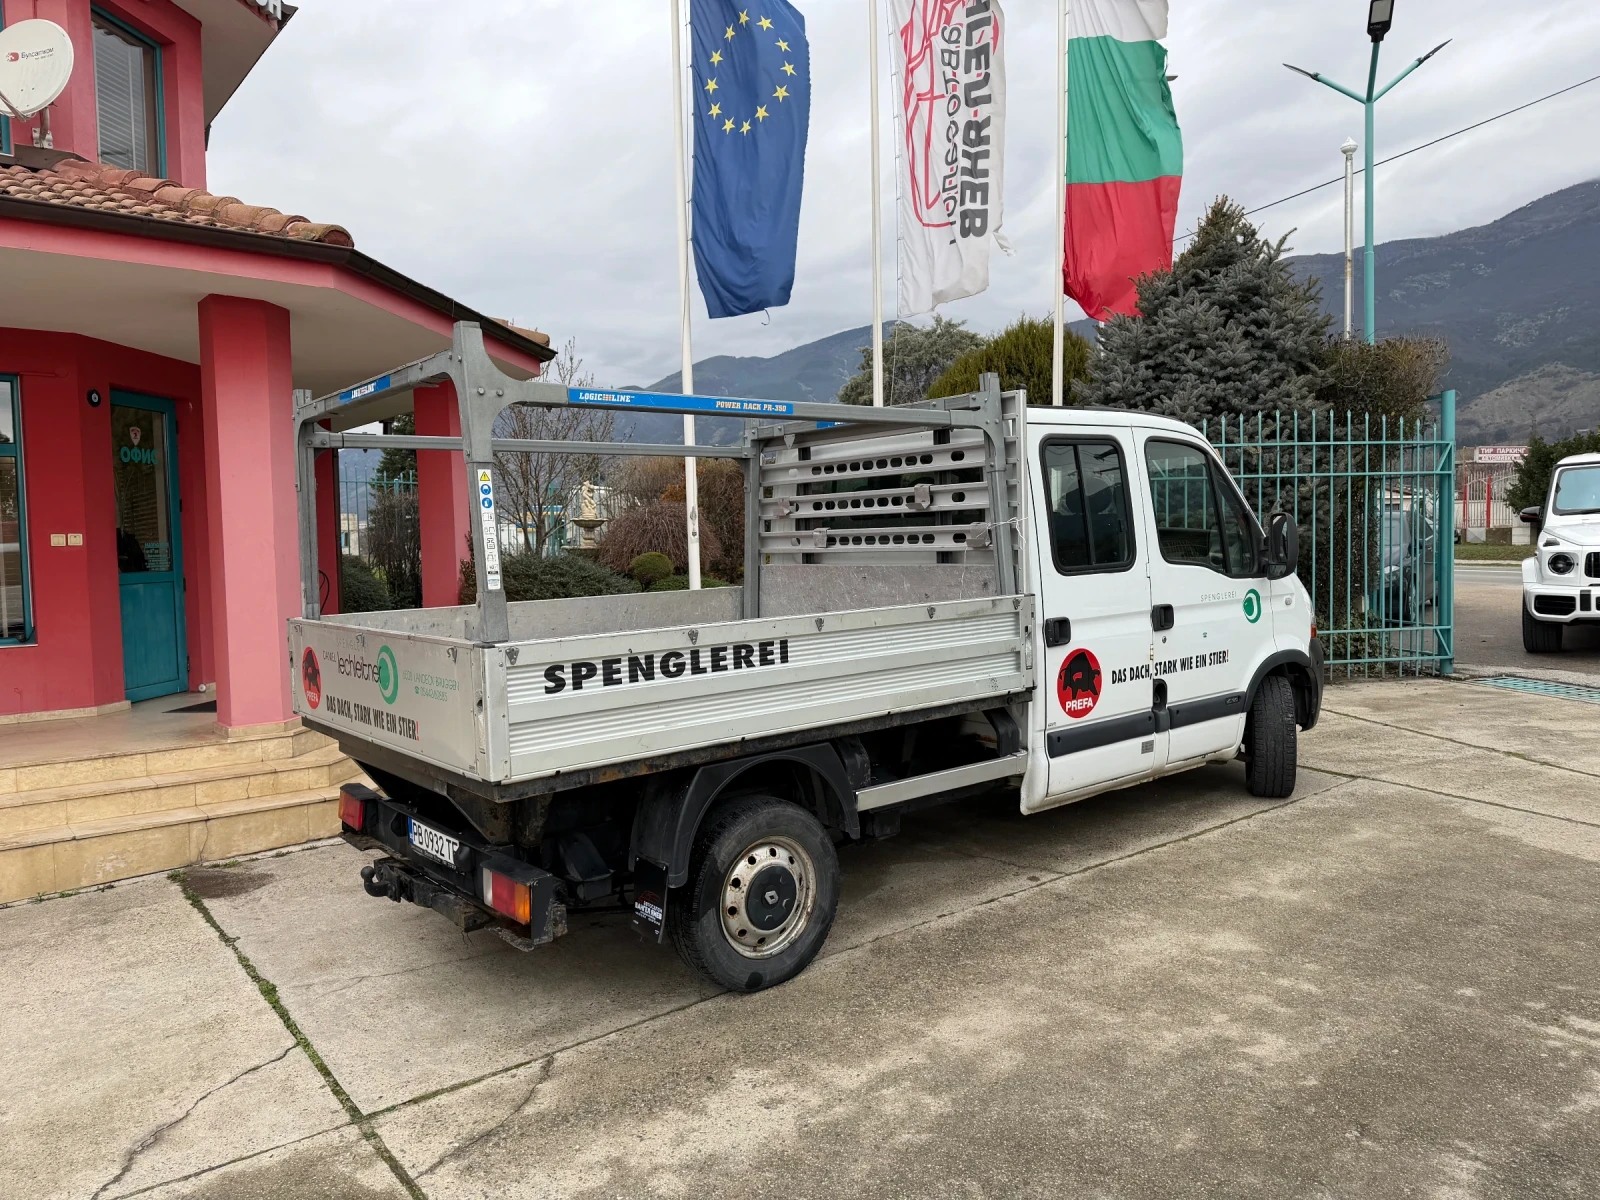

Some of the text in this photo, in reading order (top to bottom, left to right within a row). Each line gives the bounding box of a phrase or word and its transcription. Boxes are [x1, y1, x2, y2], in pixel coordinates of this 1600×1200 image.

[715, 400, 742, 410] POWER
[743, 402, 762, 411] RACK
[120, 446, 158, 465] ОФИС
[1200, 591, 1238, 602] SPENGLEREI
[544, 639, 789, 694] SPENGLEREI
[1111, 649, 1229, 684] DAS DACH, STARK WIE EIN STIER!
[306, 691, 319, 704] PREFA
[1065, 697, 1094, 712] PREFA
[326, 695, 420, 741] DAS DACH, STARK WIE EIN STIER!
